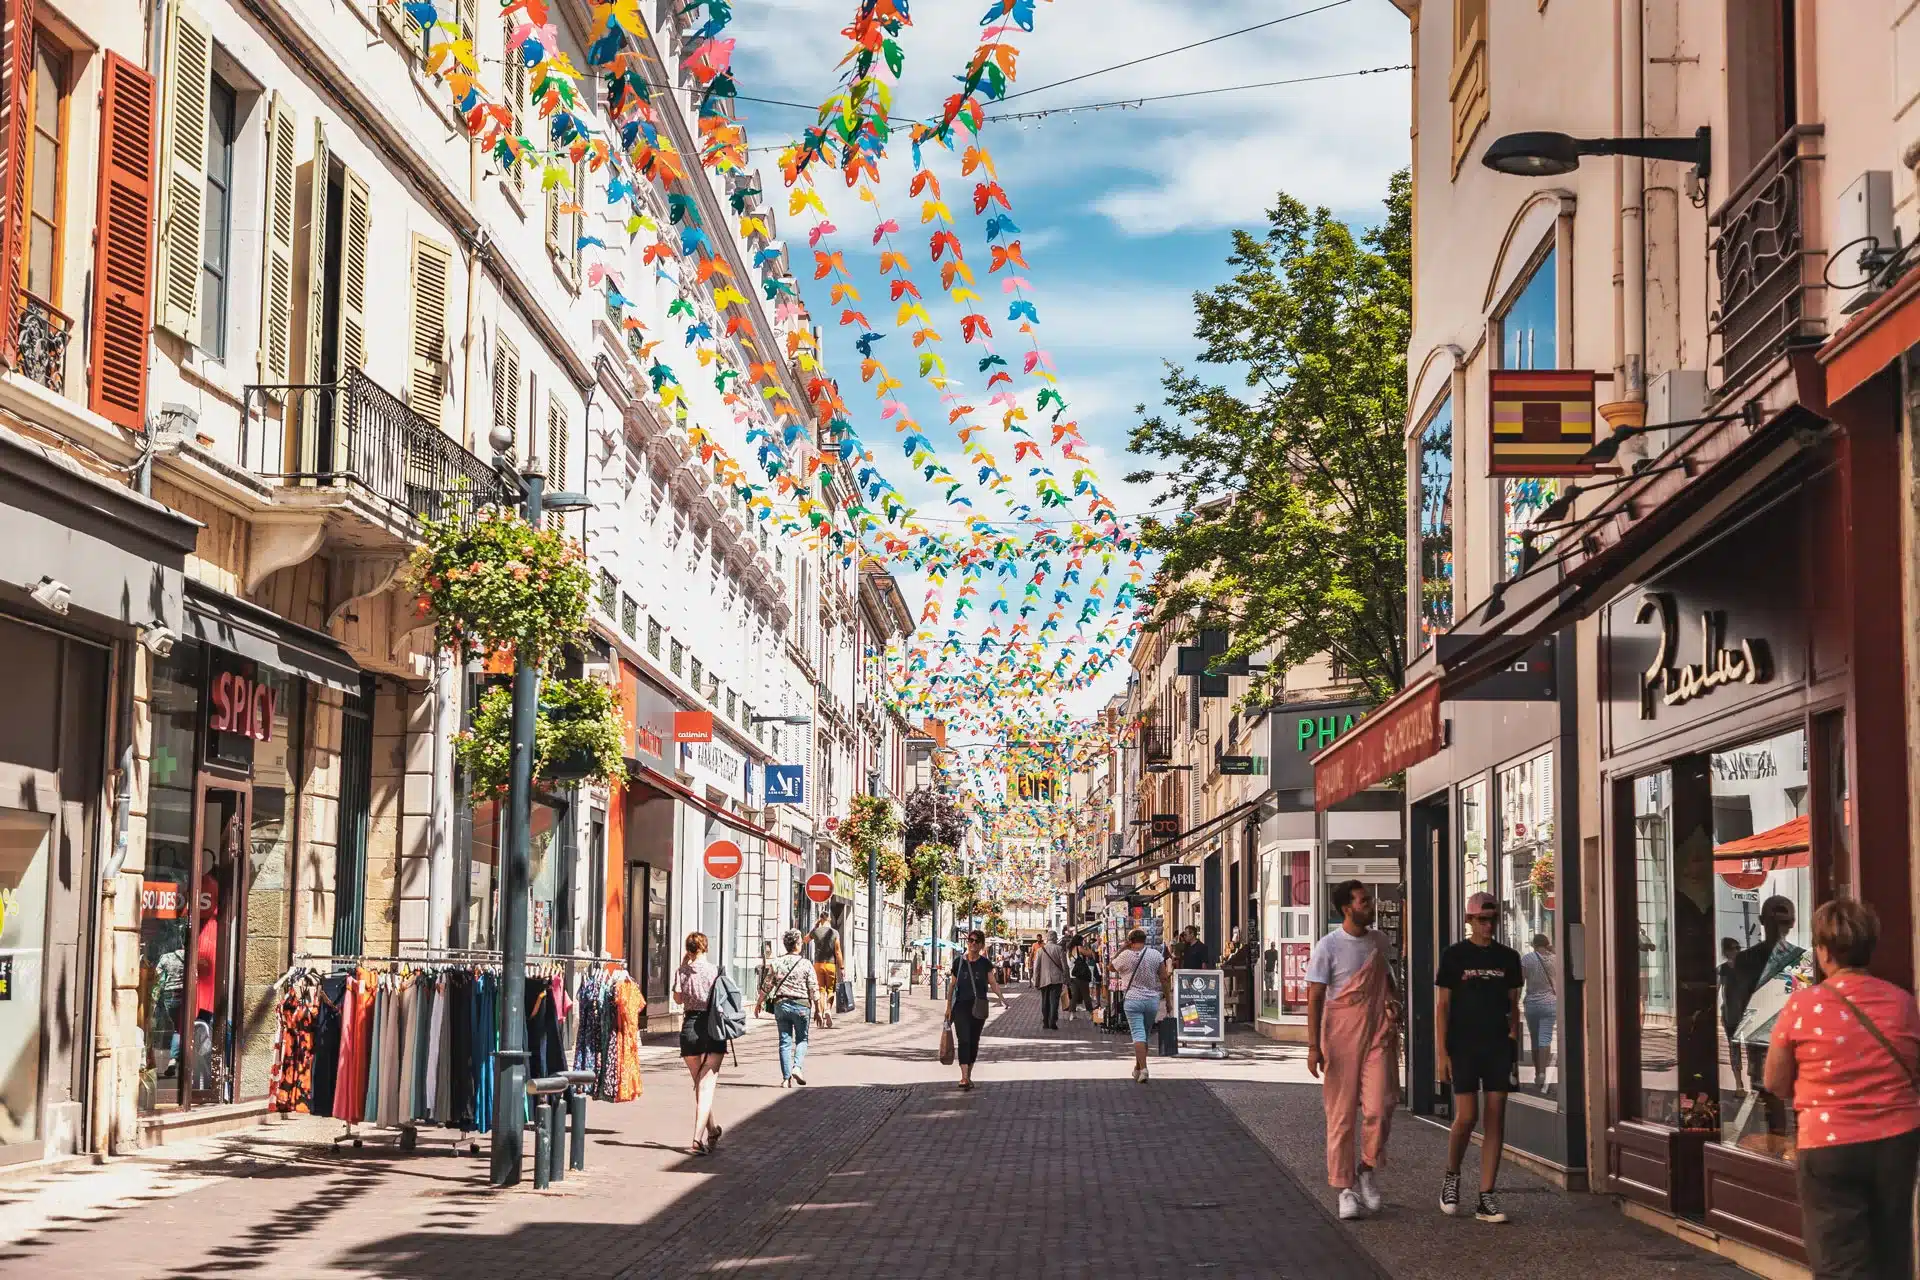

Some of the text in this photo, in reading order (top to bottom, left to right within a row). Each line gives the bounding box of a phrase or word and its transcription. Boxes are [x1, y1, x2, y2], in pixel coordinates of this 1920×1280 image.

[214, 671, 279, 742] SPICY
[1298, 714, 1354, 751] PHA
[1171, 873, 1195, 885] APRIL
[142, 890, 176, 911] SOLDES
